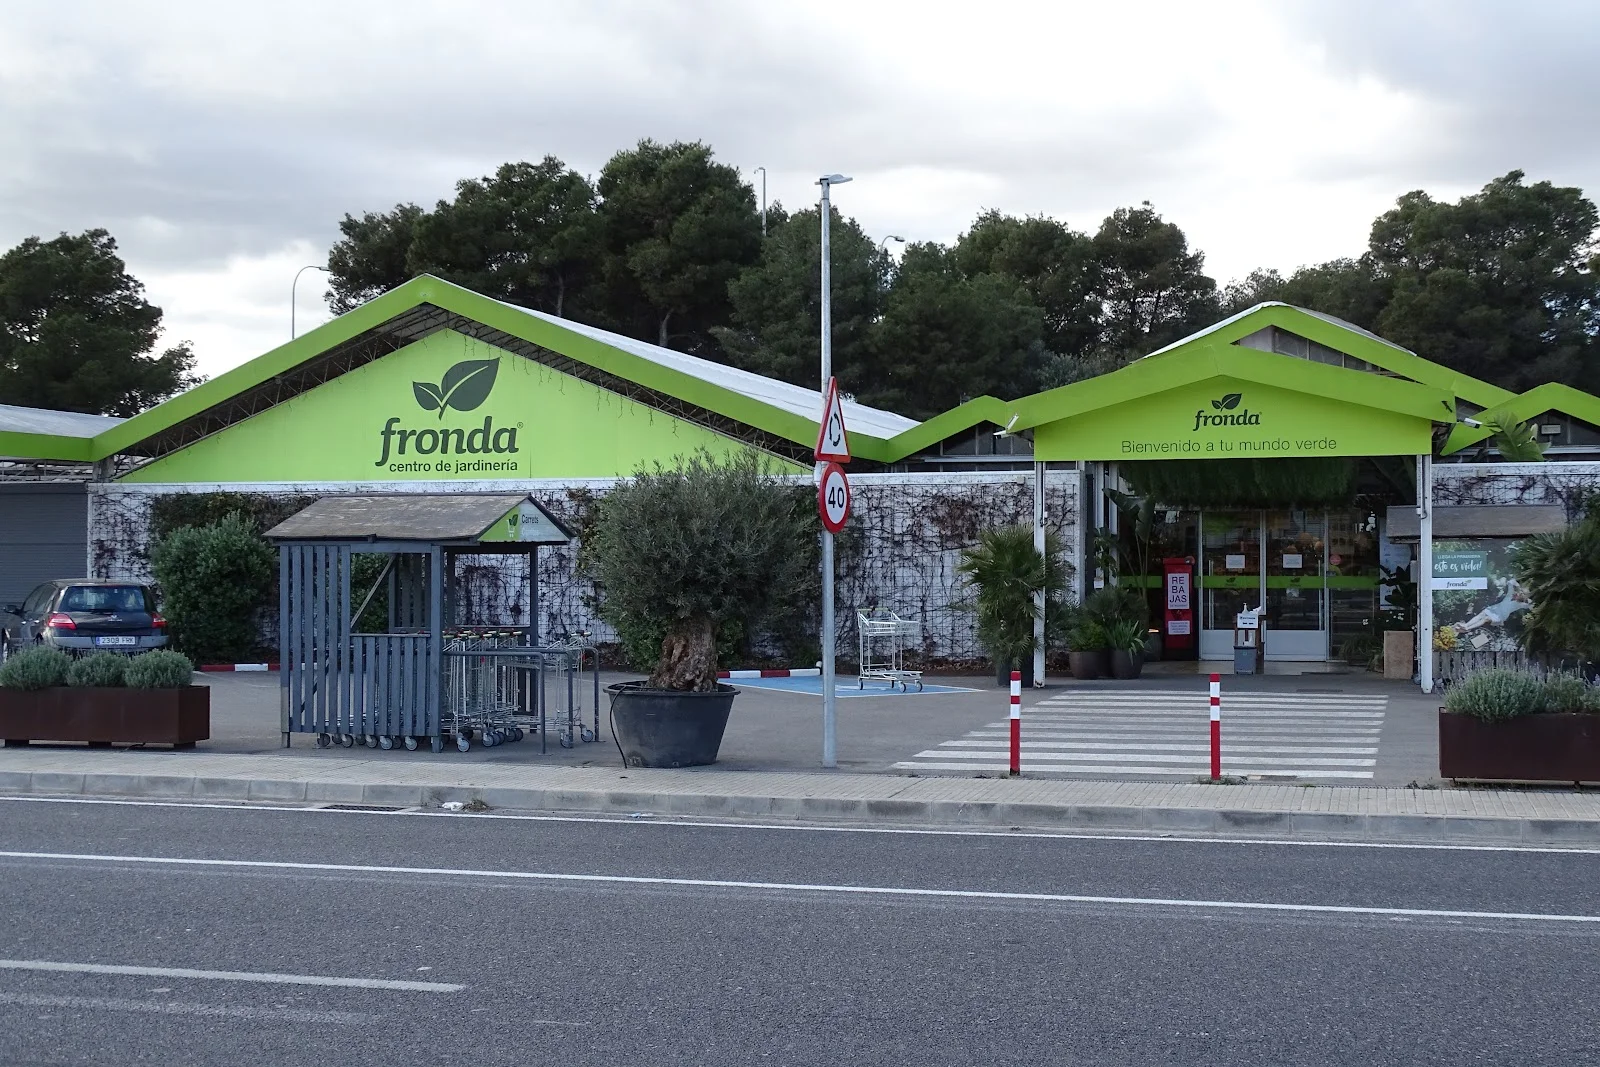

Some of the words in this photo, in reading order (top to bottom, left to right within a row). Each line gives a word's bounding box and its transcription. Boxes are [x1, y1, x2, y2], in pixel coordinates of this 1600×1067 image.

[1193, 409, 1261, 432] fronda
[375, 415, 519, 467] fronda
[1121, 440, 1201, 454] Bienvenido
[1205, 442, 1214, 452] a
[1219, 440, 1234, 452] tu
[1239, 438, 1290, 451] mundo
[1295, 437, 1337, 450] verde
[389, 460, 431, 472] centro
[435, 460, 451, 472] de
[455, 459, 518, 474] jardinería
[828, 486, 845, 509] 40
[1434, 560, 1448, 572] esto
[1450, 563, 1460, 572] es
[1460, 560, 1482, 572] vida!
[1171, 576, 1185, 585] RE
[1171, 585, 1185, 594] BA
[1169, 594, 1187, 603] JAS
